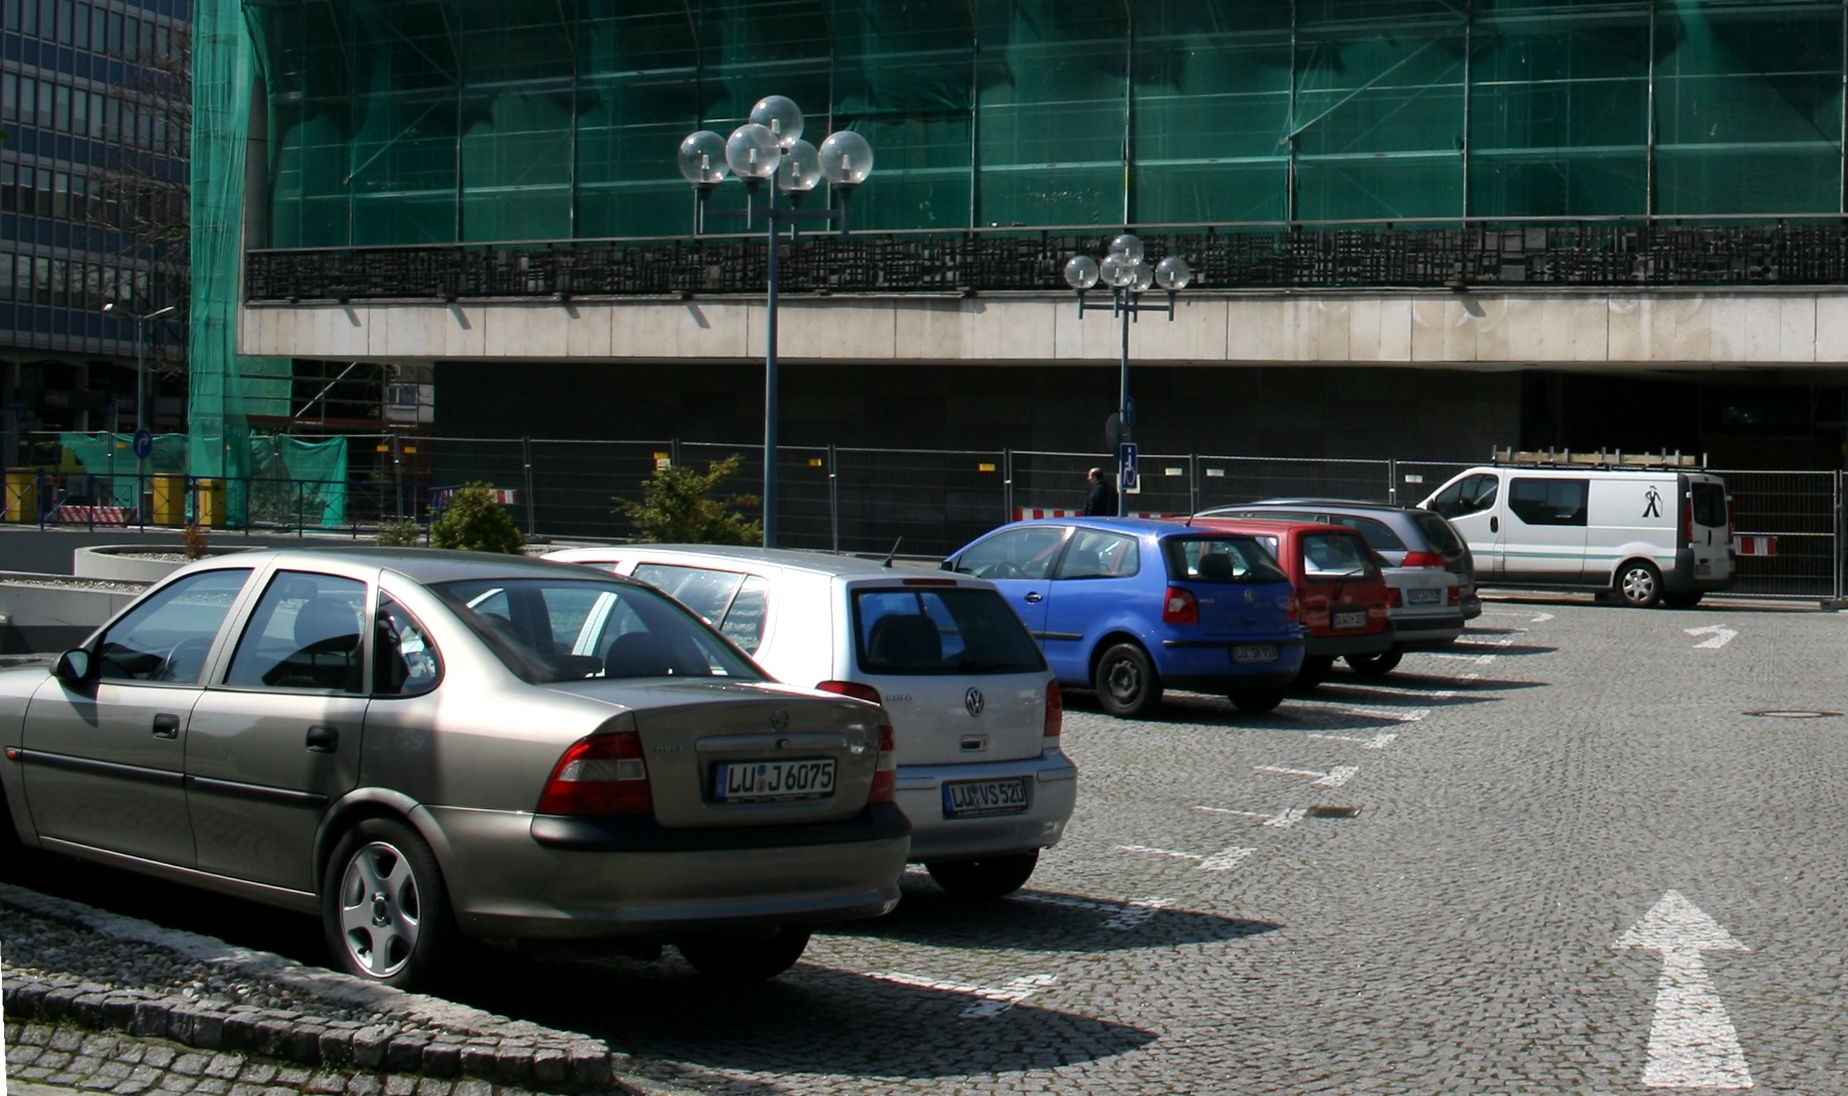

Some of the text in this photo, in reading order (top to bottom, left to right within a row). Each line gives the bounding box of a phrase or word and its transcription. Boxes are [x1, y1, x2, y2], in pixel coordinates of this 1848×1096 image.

[727, 763, 833, 793] LU J 6075
[951, 782, 1025, 808] LU VS 520
